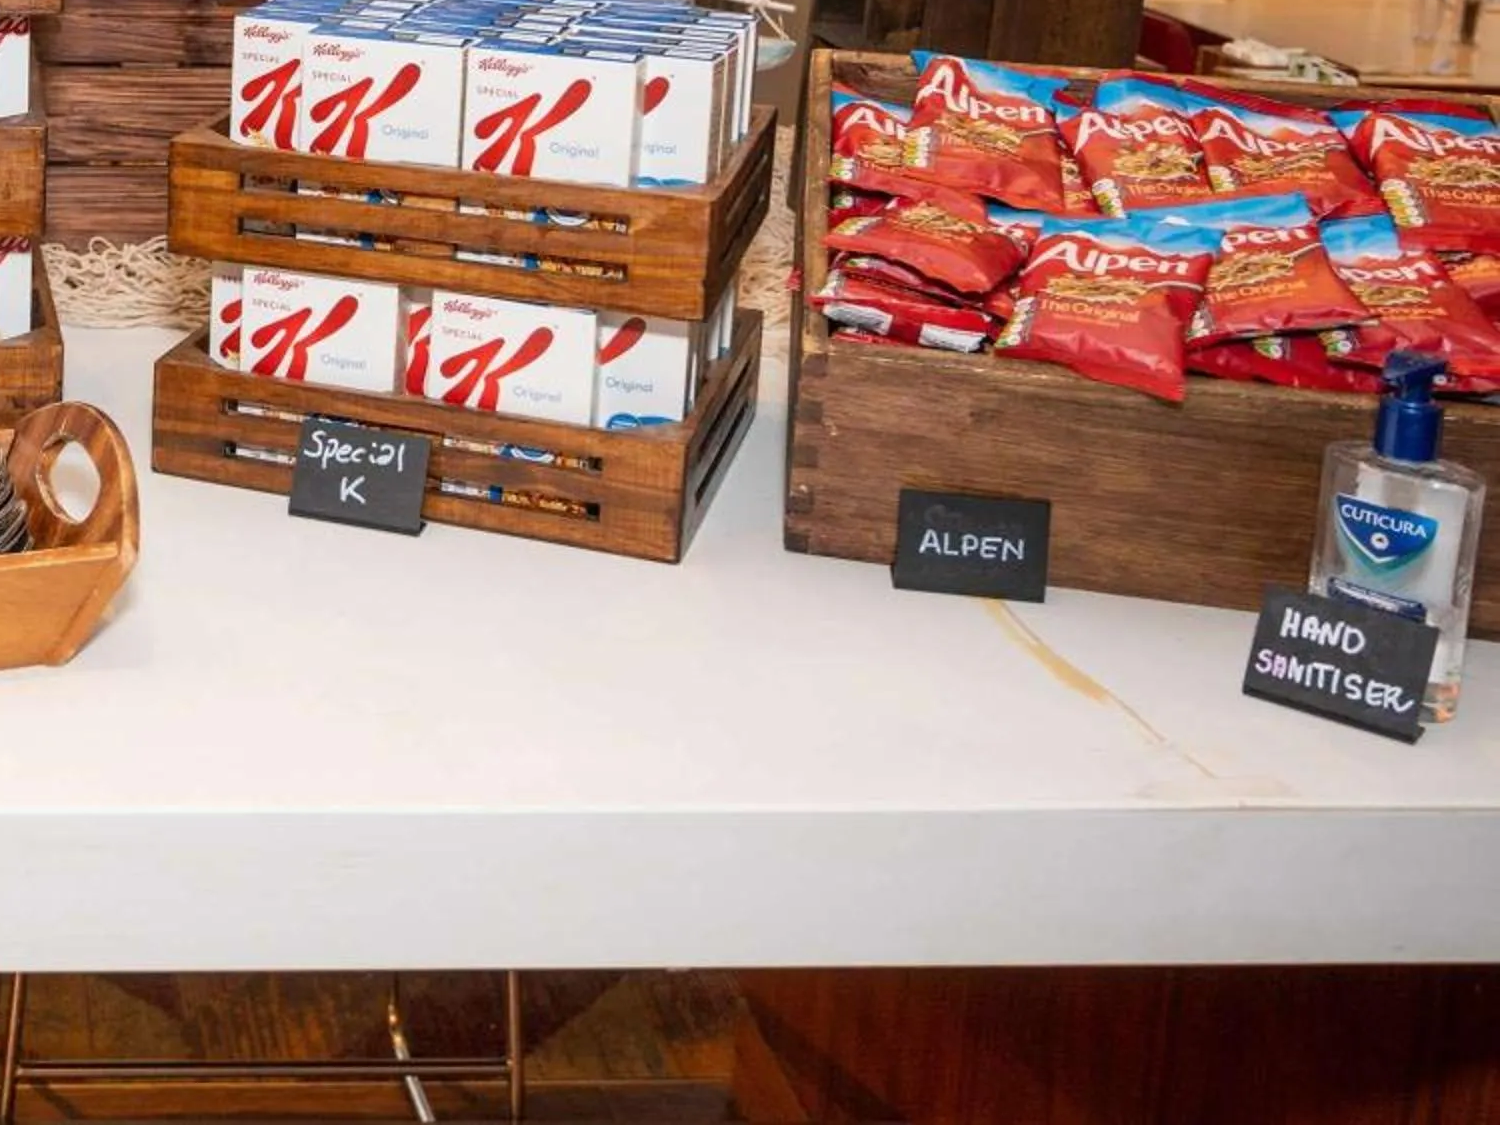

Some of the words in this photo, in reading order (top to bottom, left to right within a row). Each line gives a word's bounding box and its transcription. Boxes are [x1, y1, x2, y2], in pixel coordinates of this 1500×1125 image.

[309, 63, 421, 161] K
[915, 64, 1047, 124] Alpen
[473, 78, 593, 176] K
[1073, 111, 1199, 156] Alpen
[550, 142, 600, 159] Original
[1018, 240, 1190, 276] Alpen
[1220, 227, 1310, 252] pen
[1338, 260, 1438, 284] pen
[1040, 298, 1071, 313] The
[1071, 299, 1140, 323] Original
[250, 294, 359, 381] K
[439, 326, 554, 412] K
[604, 375, 654, 393] Original
[511, 384, 563, 403] Original
[303, 429, 406, 473] Special
[339, 474, 367, 505] K
[1340, 502, 1428, 539] CUTICURA
[918, 527, 1025, 562] ALPEN
[1280, 606, 1367, 655] HAND
[1254, 648, 1415, 713] SANITISER
